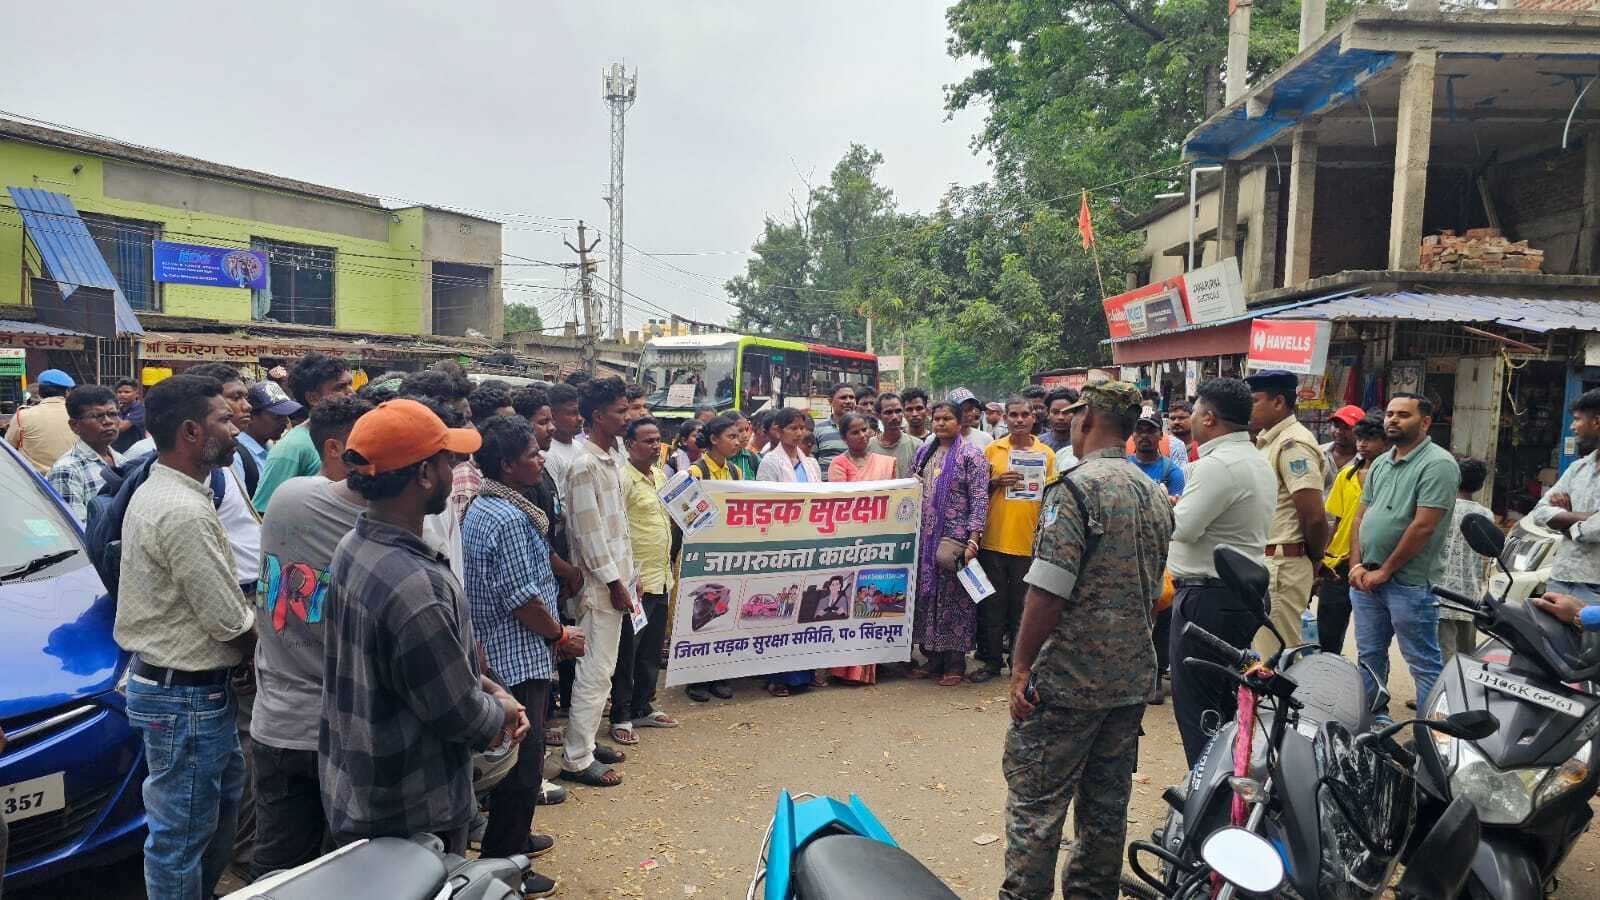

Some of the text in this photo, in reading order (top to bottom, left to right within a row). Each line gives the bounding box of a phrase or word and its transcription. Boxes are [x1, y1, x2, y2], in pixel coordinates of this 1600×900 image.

[1266, 335, 1311, 352] HAVELLS
[725, 497, 806, 535] सड़क
[808, 495, 890, 534] सुरक्षा
[818, 539, 897, 567] कार्यक्रम
[673, 640, 710, 660] जिला
[713, 636, 749, 656] सड़क
[752, 633, 789, 655] सुरक्षा
[858, 622, 904, 643] सिंहभूम
[4, 791, 45, 815] 357
